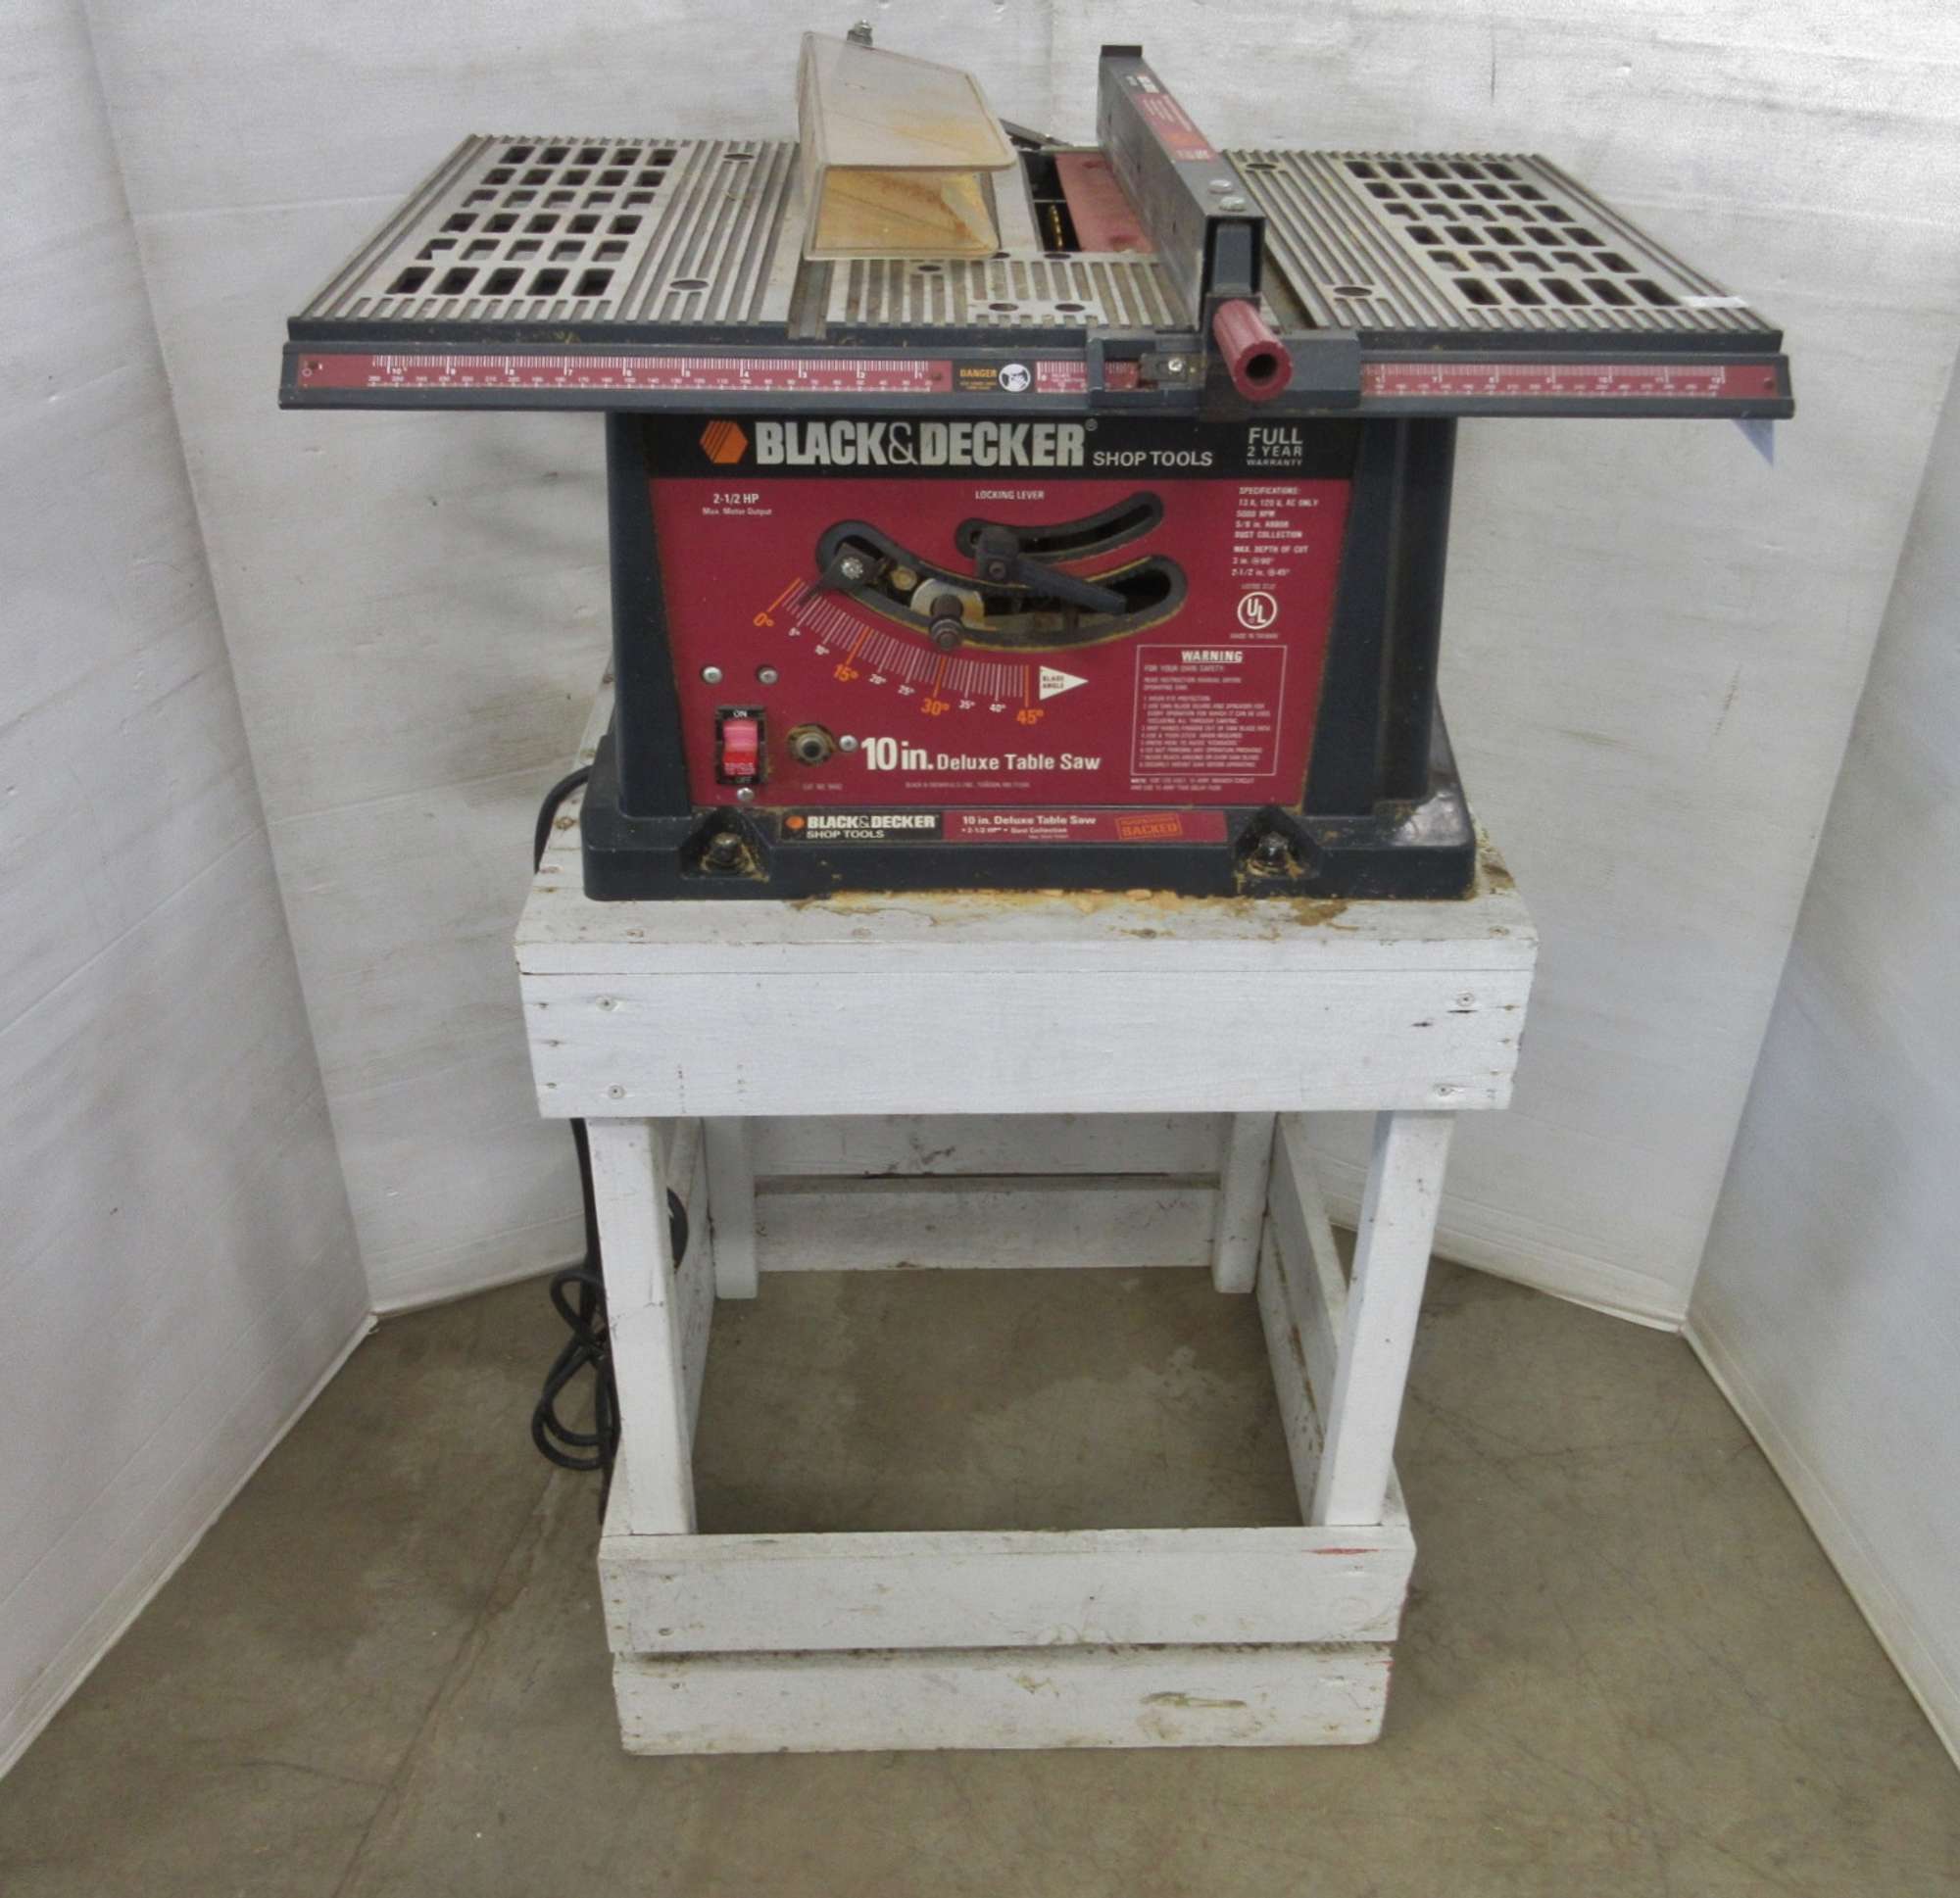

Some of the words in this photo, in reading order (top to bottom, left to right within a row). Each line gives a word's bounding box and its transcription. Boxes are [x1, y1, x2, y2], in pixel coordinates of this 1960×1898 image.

[959, 368, 997, 377] DANGER
[1249, 427, 1303, 445] FULL
[1247, 446, 1255, 457] 2
[1261, 446, 1302, 457] YEAR
[1093, 451, 1147, 466] SHOP
[1150, 451, 1213, 466] TOOLS
[713, 493, 741, 505] 2-1/2
[743, 493, 760, 504] HP
[975, 490, 1015, 500] LOCKING
[1016, 490, 1045, 500] LEVER
[747, 508, 772, 516] Output
[1256, 530, 1302, 539] COLLECTION
[1247, 598, 1266, 623] UL
[1181, 650, 1243, 662] WARNING
[860, 737, 897, 771] 10
[901, 741, 934, 770] in.
[937, 754, 1000, 771] Deluxe
[1004, 754, 1055, 771] Table
[1059, 754, 1101, 771] Saw
[807, 815, 935, 829] BLACK&DECKER
[962, 815, 976, 825] 10
[978, 815, 991, 825] in.
[994, 815, 1035, 825] Deluxe
[1037, 815, 1067, 825] Table
[1069, 815, 1097, 825] Saw
[806, 830, 841, 839] SHOP
[845, 830, 885, 839] TOOLS
